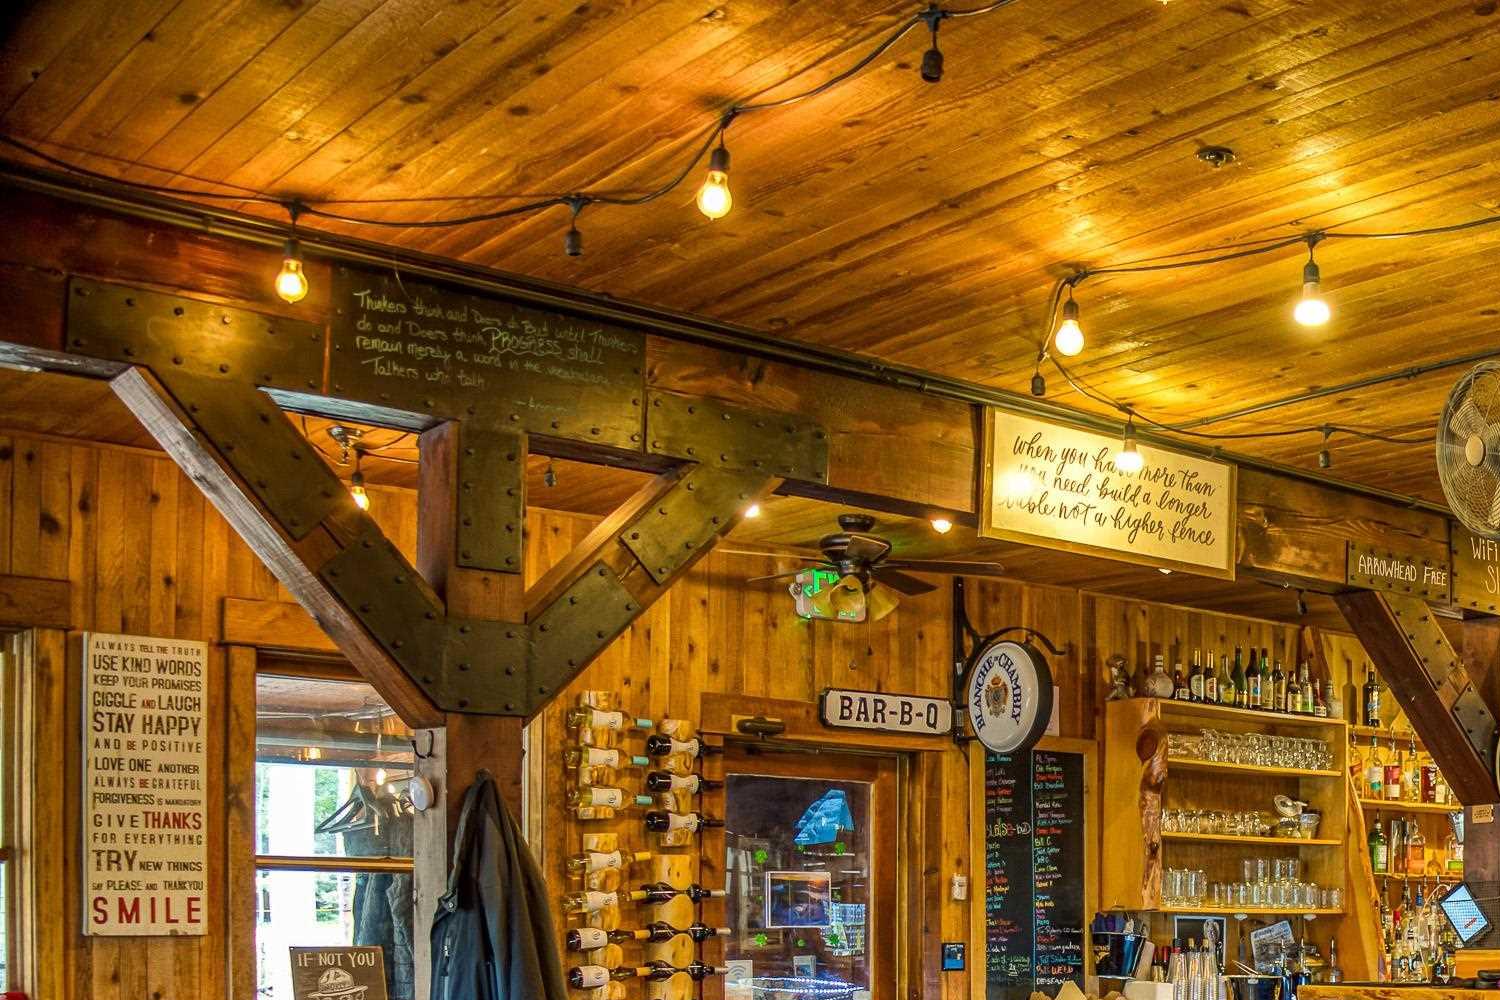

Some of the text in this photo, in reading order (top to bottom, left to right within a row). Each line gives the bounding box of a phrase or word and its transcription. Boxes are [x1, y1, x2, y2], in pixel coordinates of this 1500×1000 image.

[377, 321, 402, 335] and
[356, 335, 402, 354] remain
[1057, 447, 1088, 475] you
[1138, 464, 1177, 488] more
[1053, 474, 1213, 528] need build a longer
[1094, 511, 1108, 528] a
[1110, 506, 1166, 545] higher
[1169, 520, 1216, 547] fence
[1471, 537, 1499, 562] WiFi
[1358, 554, 1418, 583] ARROWHEAD
[95, 641, 201, 656] ALWAYS TELL THE TRUTH
[93, 654, 202, 677] USE KIND WORDS
[94, 674, 202, 692] KEEP YOUR PROMISES
[975, 655, 994, 733] BLANCHE
[998, 652, 1023, 726] CHAMBLY
[93, 691, 201, 712] GIGGLE AND LAUGH
[838, 694, 939, 730] BAR-B-Q
[93, 711, 202, 737] STAY HAPPY
[94, 738, 202, 753] AND BE POSITIVE
[95, 757, 199, 775] LOVE ONE ANOTHER
[94, 776, 201, 791] ALWAYS BE GRATEFUL
[93, 792, 155, 806] FORGIVENESS
[93, 811, 202, 830] GIVE THANKS
[93, 832, 203, 846] FOR EVERYTHING
[92, 849, 203, 872] TRY NEW THINGS
[92, 882, 103, 891] SAY
[106, 880, 142, 891] PLEASE
[145, 882, 158, 891] AND
[93, 896, 201, 925] SMILE
[298, 952, 375, 968] IF NOT YOU
